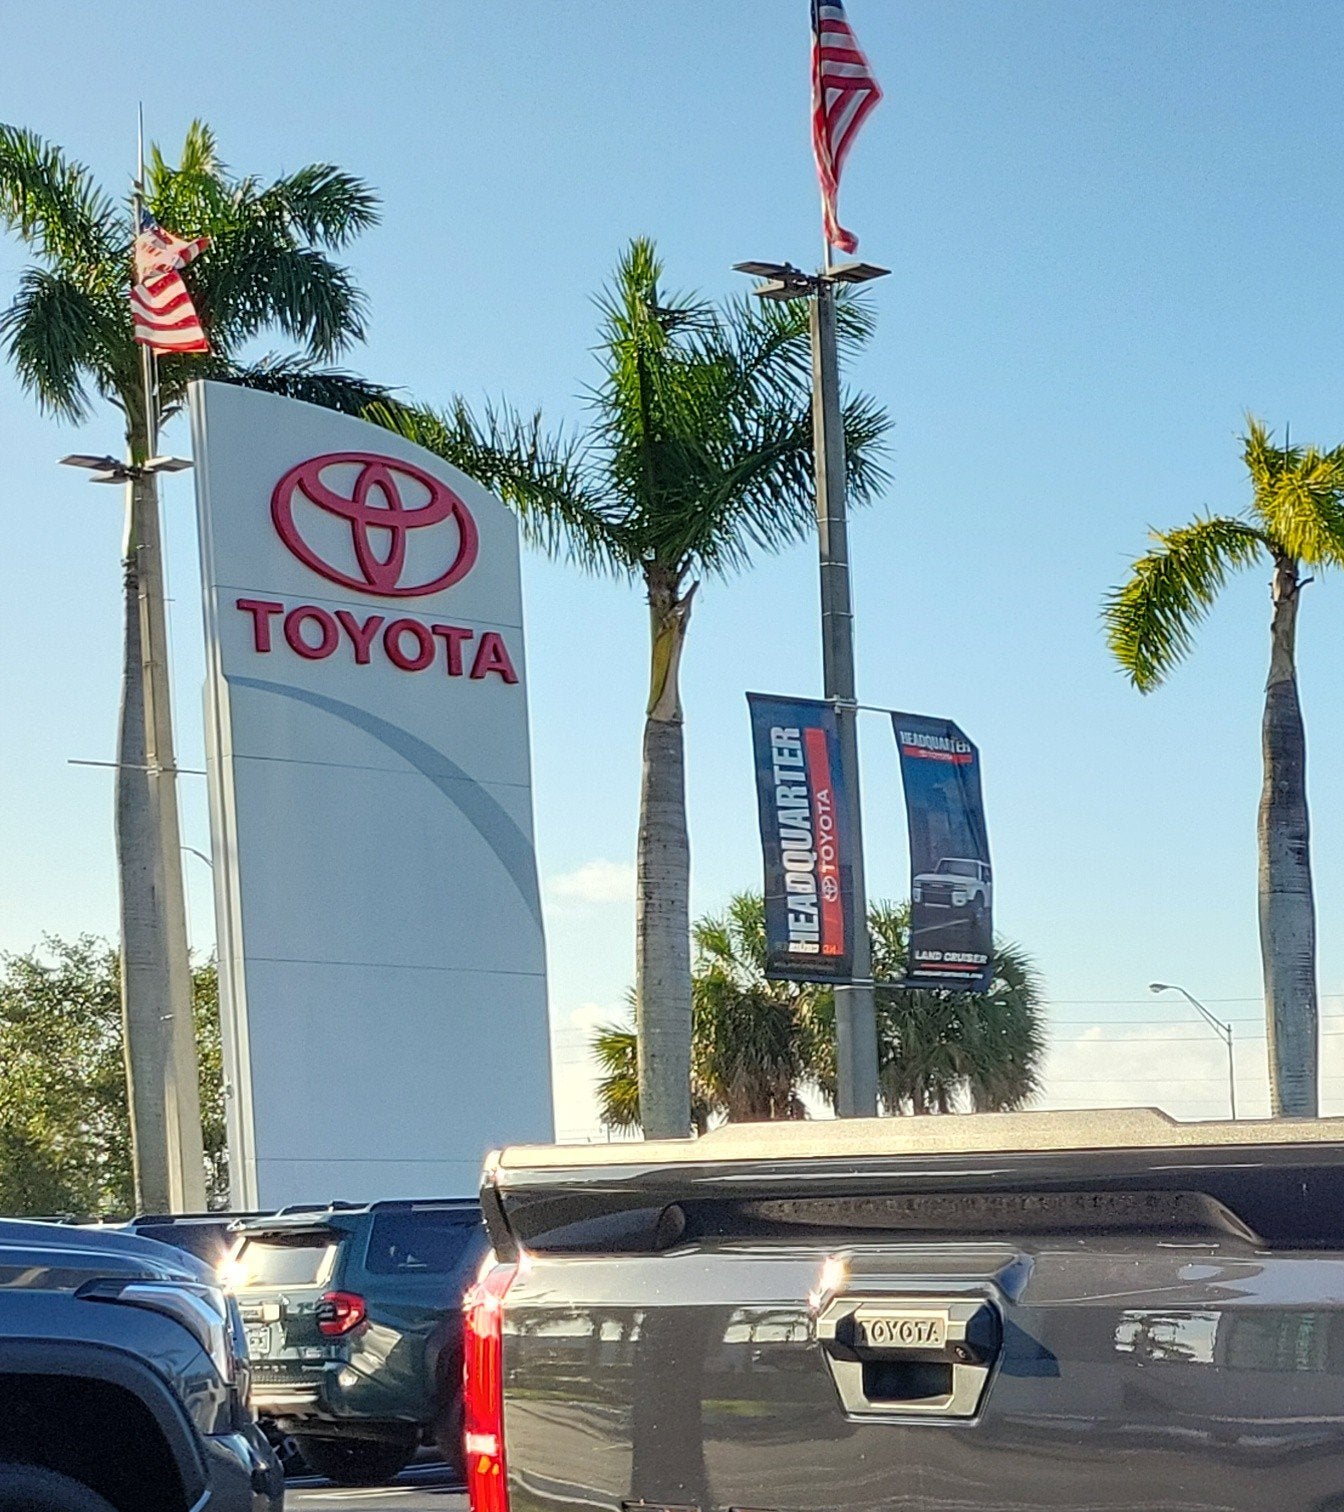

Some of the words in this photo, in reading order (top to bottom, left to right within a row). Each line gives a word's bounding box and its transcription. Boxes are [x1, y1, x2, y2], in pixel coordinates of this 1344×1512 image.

[236, 598, 519, 684] TOYOTA
[770, 727, 820, 954] HEADQUARTER
[816, 788, 834, 875] TOYOTA
[914, 950, 942, 960] LAND
[943, 952, 988, 964] CRUISER
[860, 1319, 940, 1344] TOYOTA
